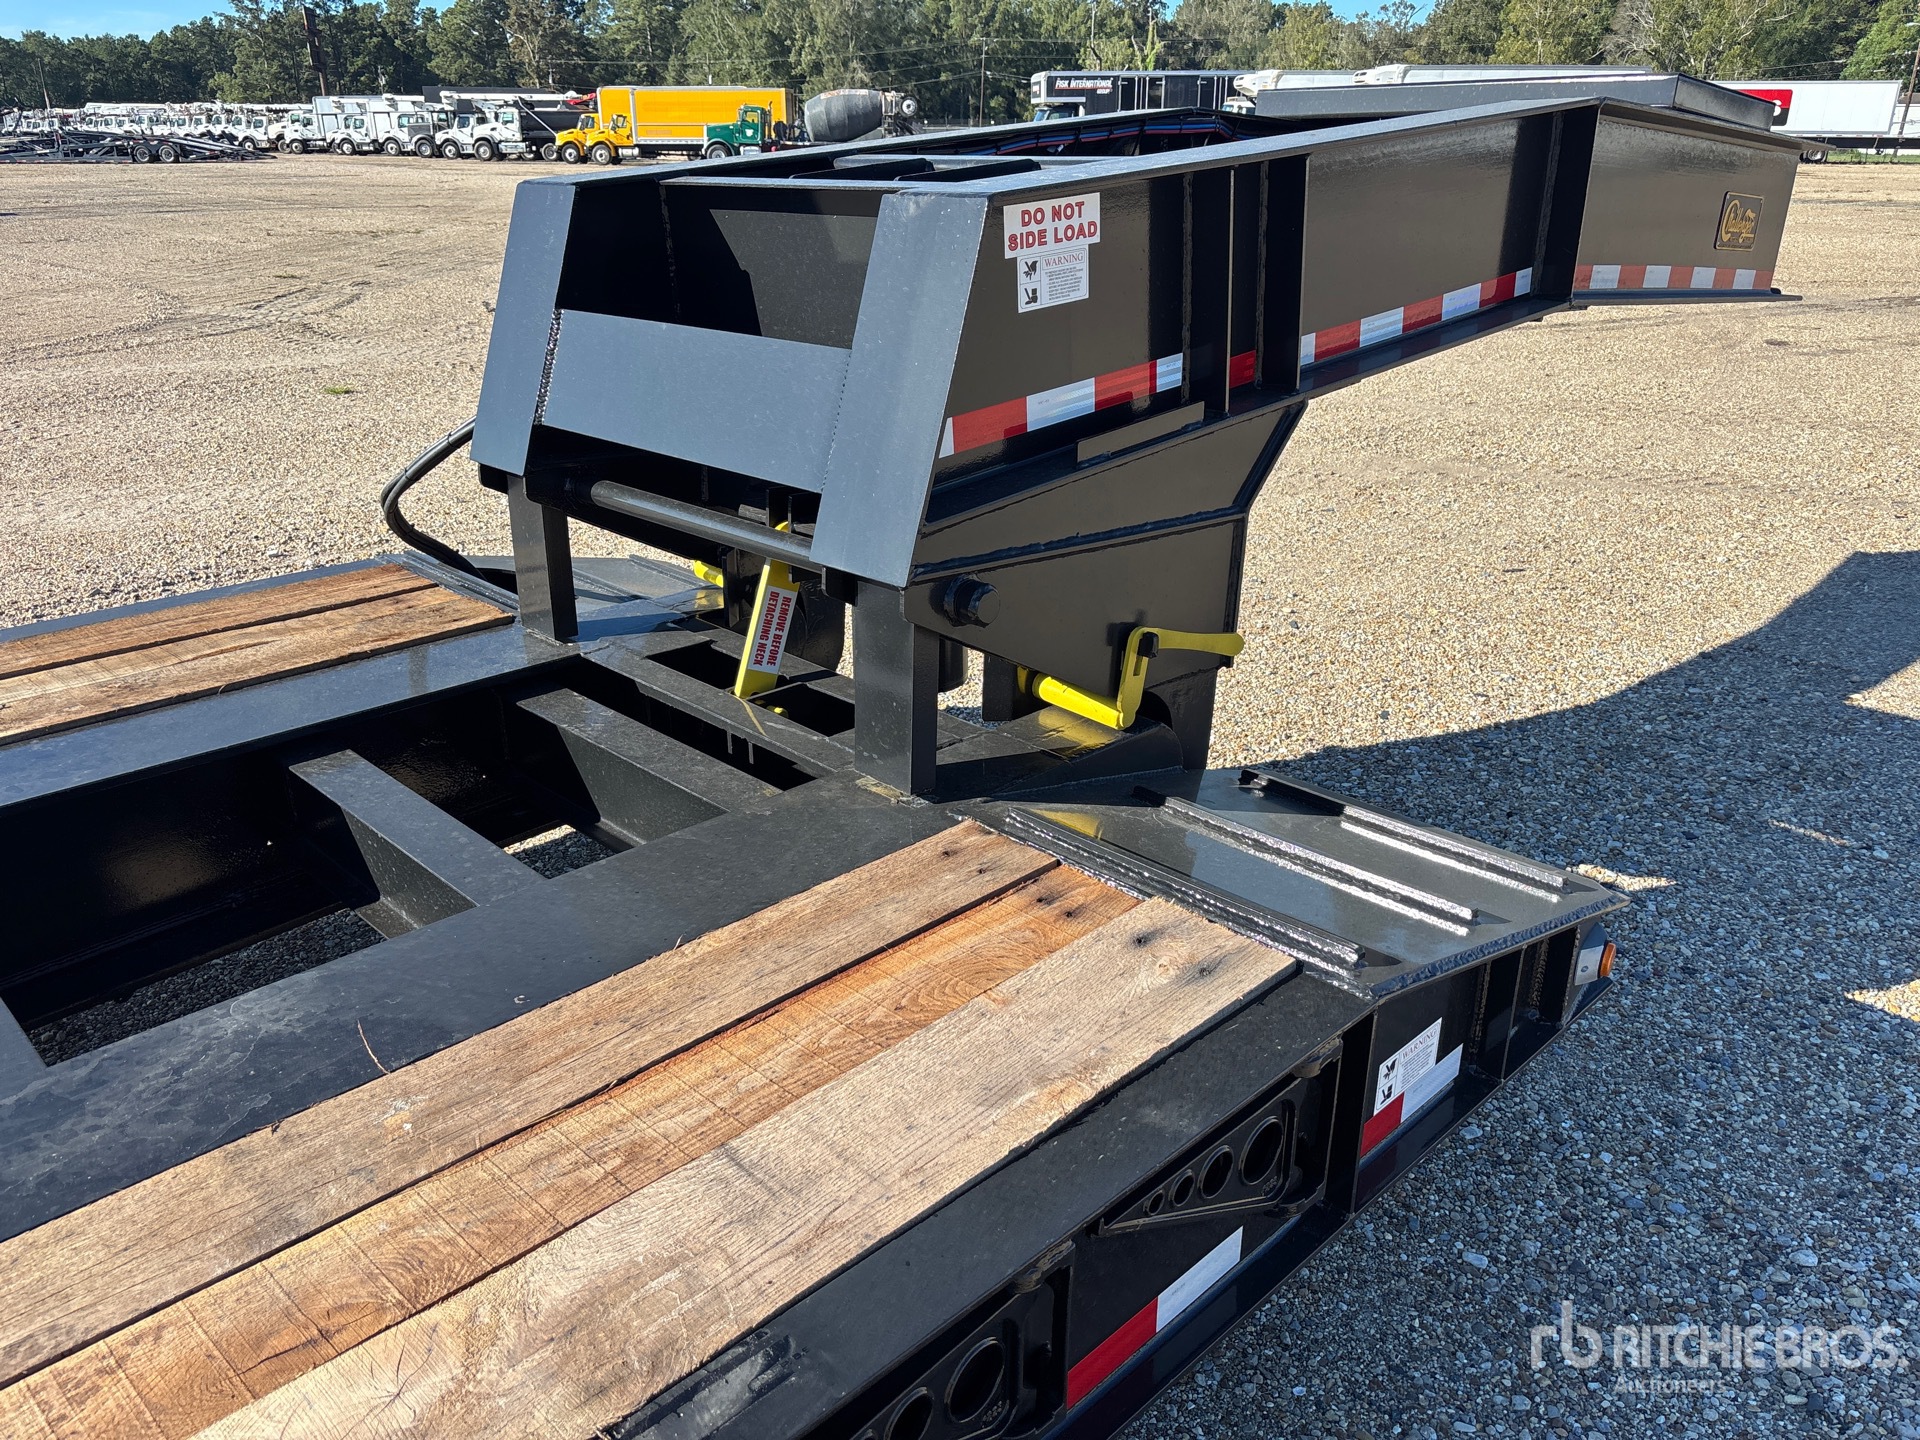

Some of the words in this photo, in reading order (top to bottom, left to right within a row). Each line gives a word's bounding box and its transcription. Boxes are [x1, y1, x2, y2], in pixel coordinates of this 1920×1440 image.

[1020, 207, 1045, 227] DO
[1051, 201, 1085, 222] NOT
[1008, 228, 1048, 251] SIDE
[1053, 221, 1098, 244] LOAD
[1044, 252, 1084, 267] WARNING
[759, 591, 780, 641] DETACHING
[774, 596, 792, 633] REMOVE
[753, 642, 768, 666] NECK
[766, 631, 783, 666] BEFORE
[1402, 1028, 1437, 1059] WARNING
